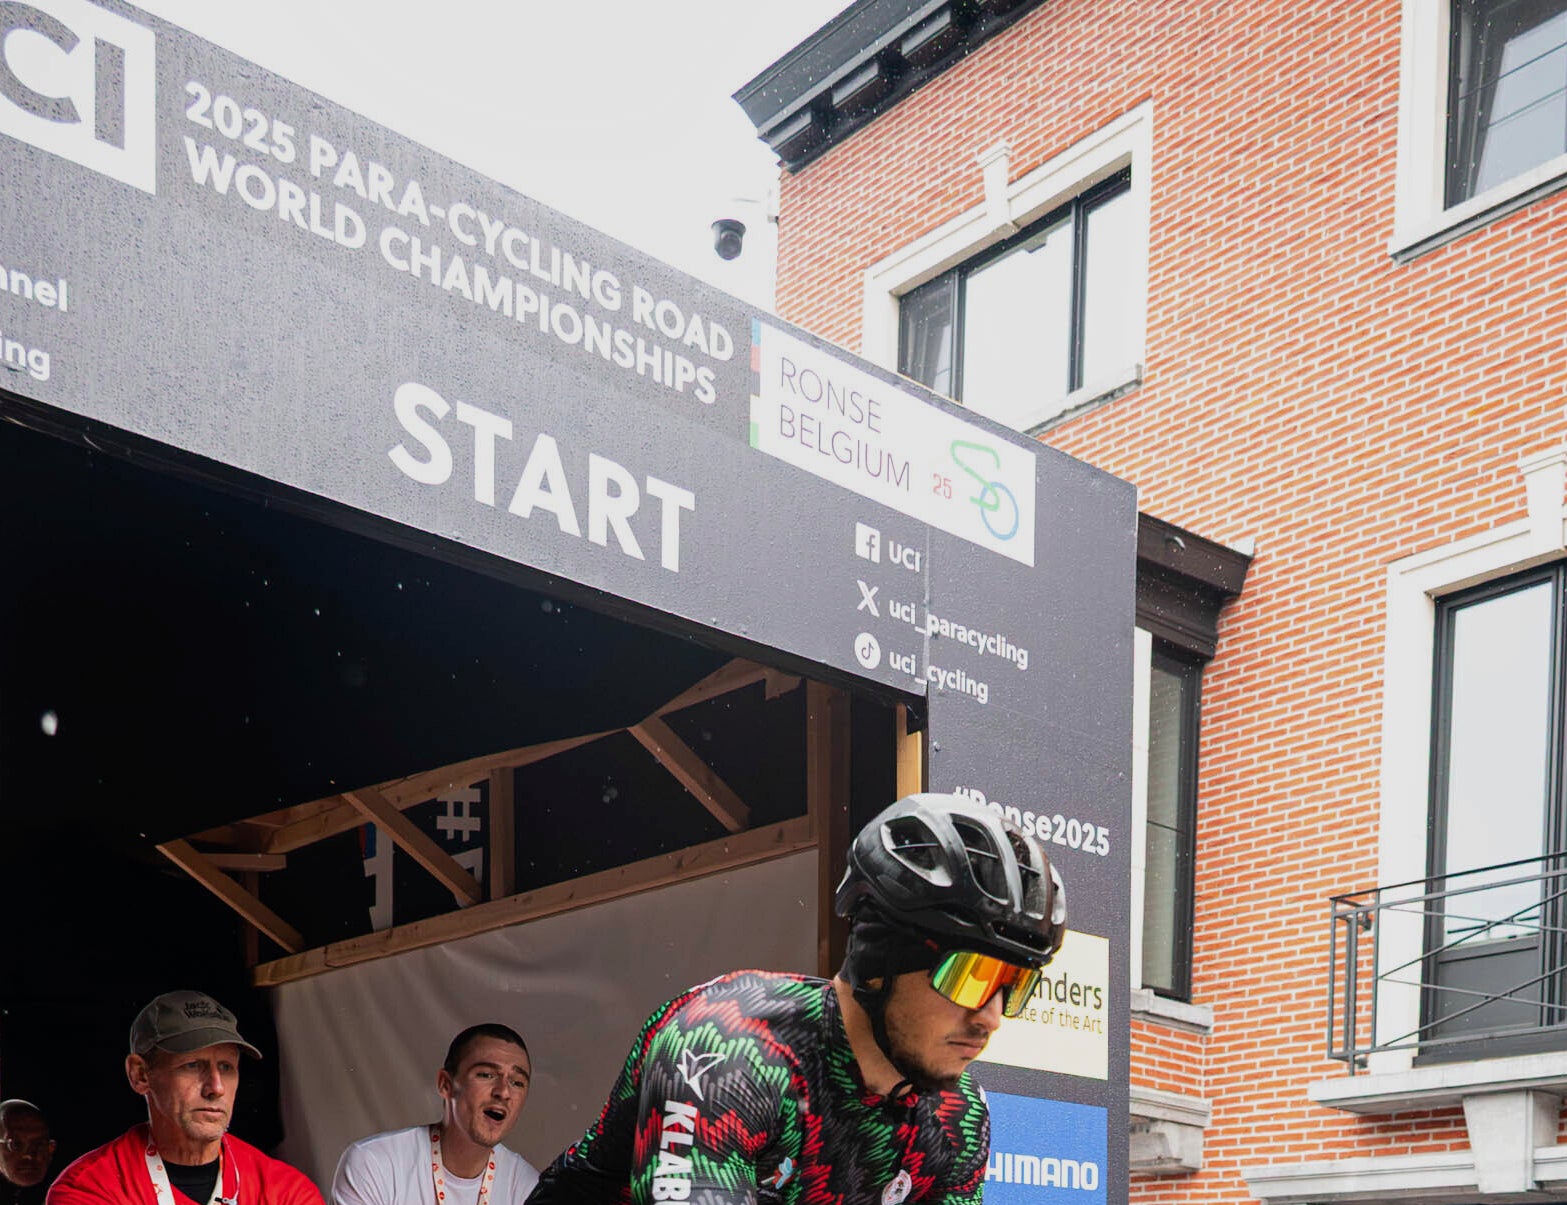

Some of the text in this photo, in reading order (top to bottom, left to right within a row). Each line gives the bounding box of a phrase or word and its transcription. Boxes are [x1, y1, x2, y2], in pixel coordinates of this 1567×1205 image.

[185, 81, 735, 362] 2025 PARA-CYCLING ROAD
[184, 136, 717, 406] WORLD CHAMPIONSHIPS
[780, 356, 883, 434] RONSE
[387, 381, 696, 574] START
[779, 404, 910, 492] BELGIUM
[932, 473, 953, 501] 25
[889, 599, 1029, 671] uci_paracycling
[889, 651, 989, 704] uci_cycling
[1033, 972, 1103, 1011] nders
[1041, 1007, 1055, 1025] of
[1059, 1007, 1080, 1030] the
[1082, 1015, 1103, 1035] Art
[984, 1152, 1099, 1191] HIMANO
